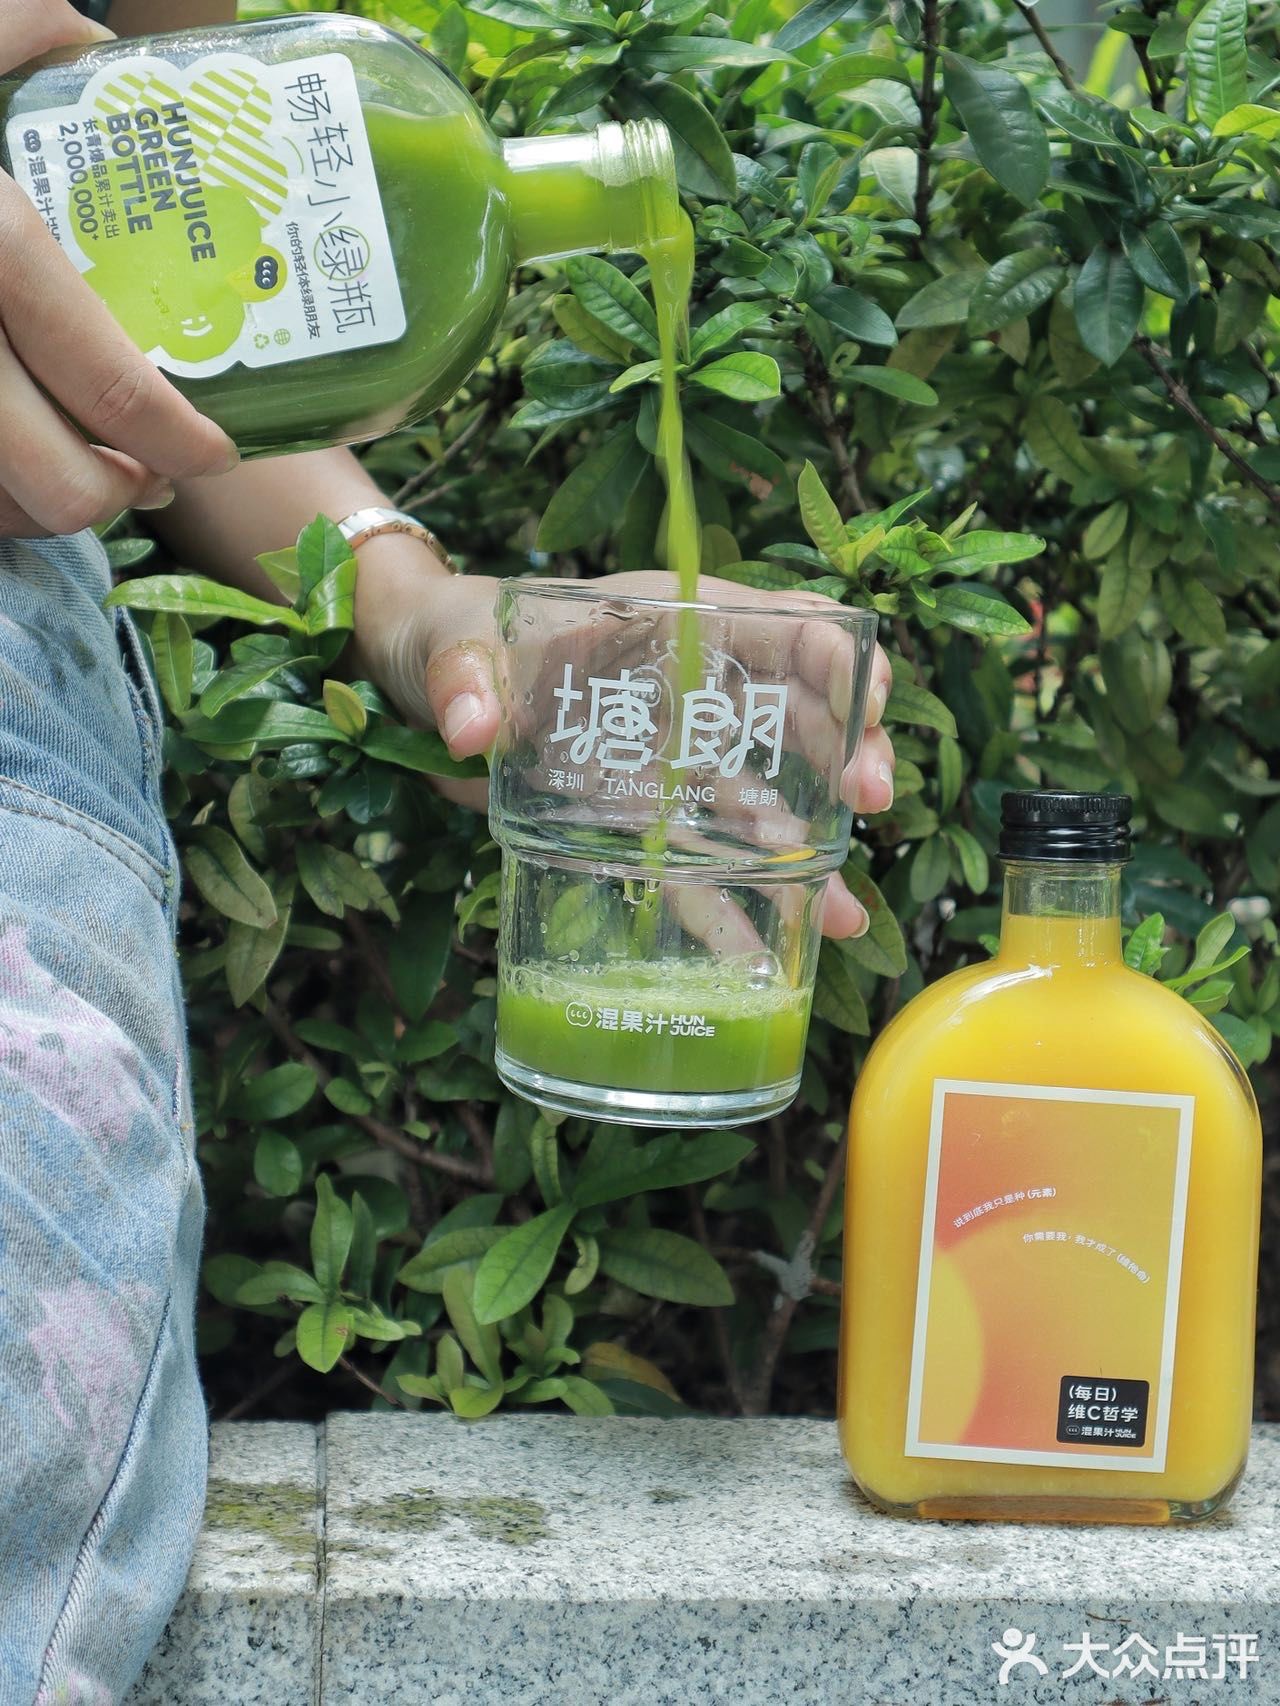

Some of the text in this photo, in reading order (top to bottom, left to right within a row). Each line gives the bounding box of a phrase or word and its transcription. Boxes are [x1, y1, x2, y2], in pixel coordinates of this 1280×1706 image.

[58, 122, 99, 241] 2,000,000+
[82, 118, 119, 239] 长青爆品累计卖出
[105, 113, 153, 235] BOTTLE
[134, 107, 177, 212] GREEN
[161, 101, 216, 263] HUNJUICE
[285, 72, 375, 334] 畅轻小绿瓶
[285, 221, 320, 340] 你的轻体绿朋友
[549, 663, 789, 780] 塘朗
[548, 768, 778, 807] 深圳 TANGLANG 塘朗
[595, 1006, 705, 1035] 混果汁 HUN
[669, 1025, 715, 1037] JUICE
[1067, 1404, 1139, 1423] 维C哲学
[1069, 1384, 1117, 1402] (每日)
[1081, 1425, 1114, 1437] 混果汁
